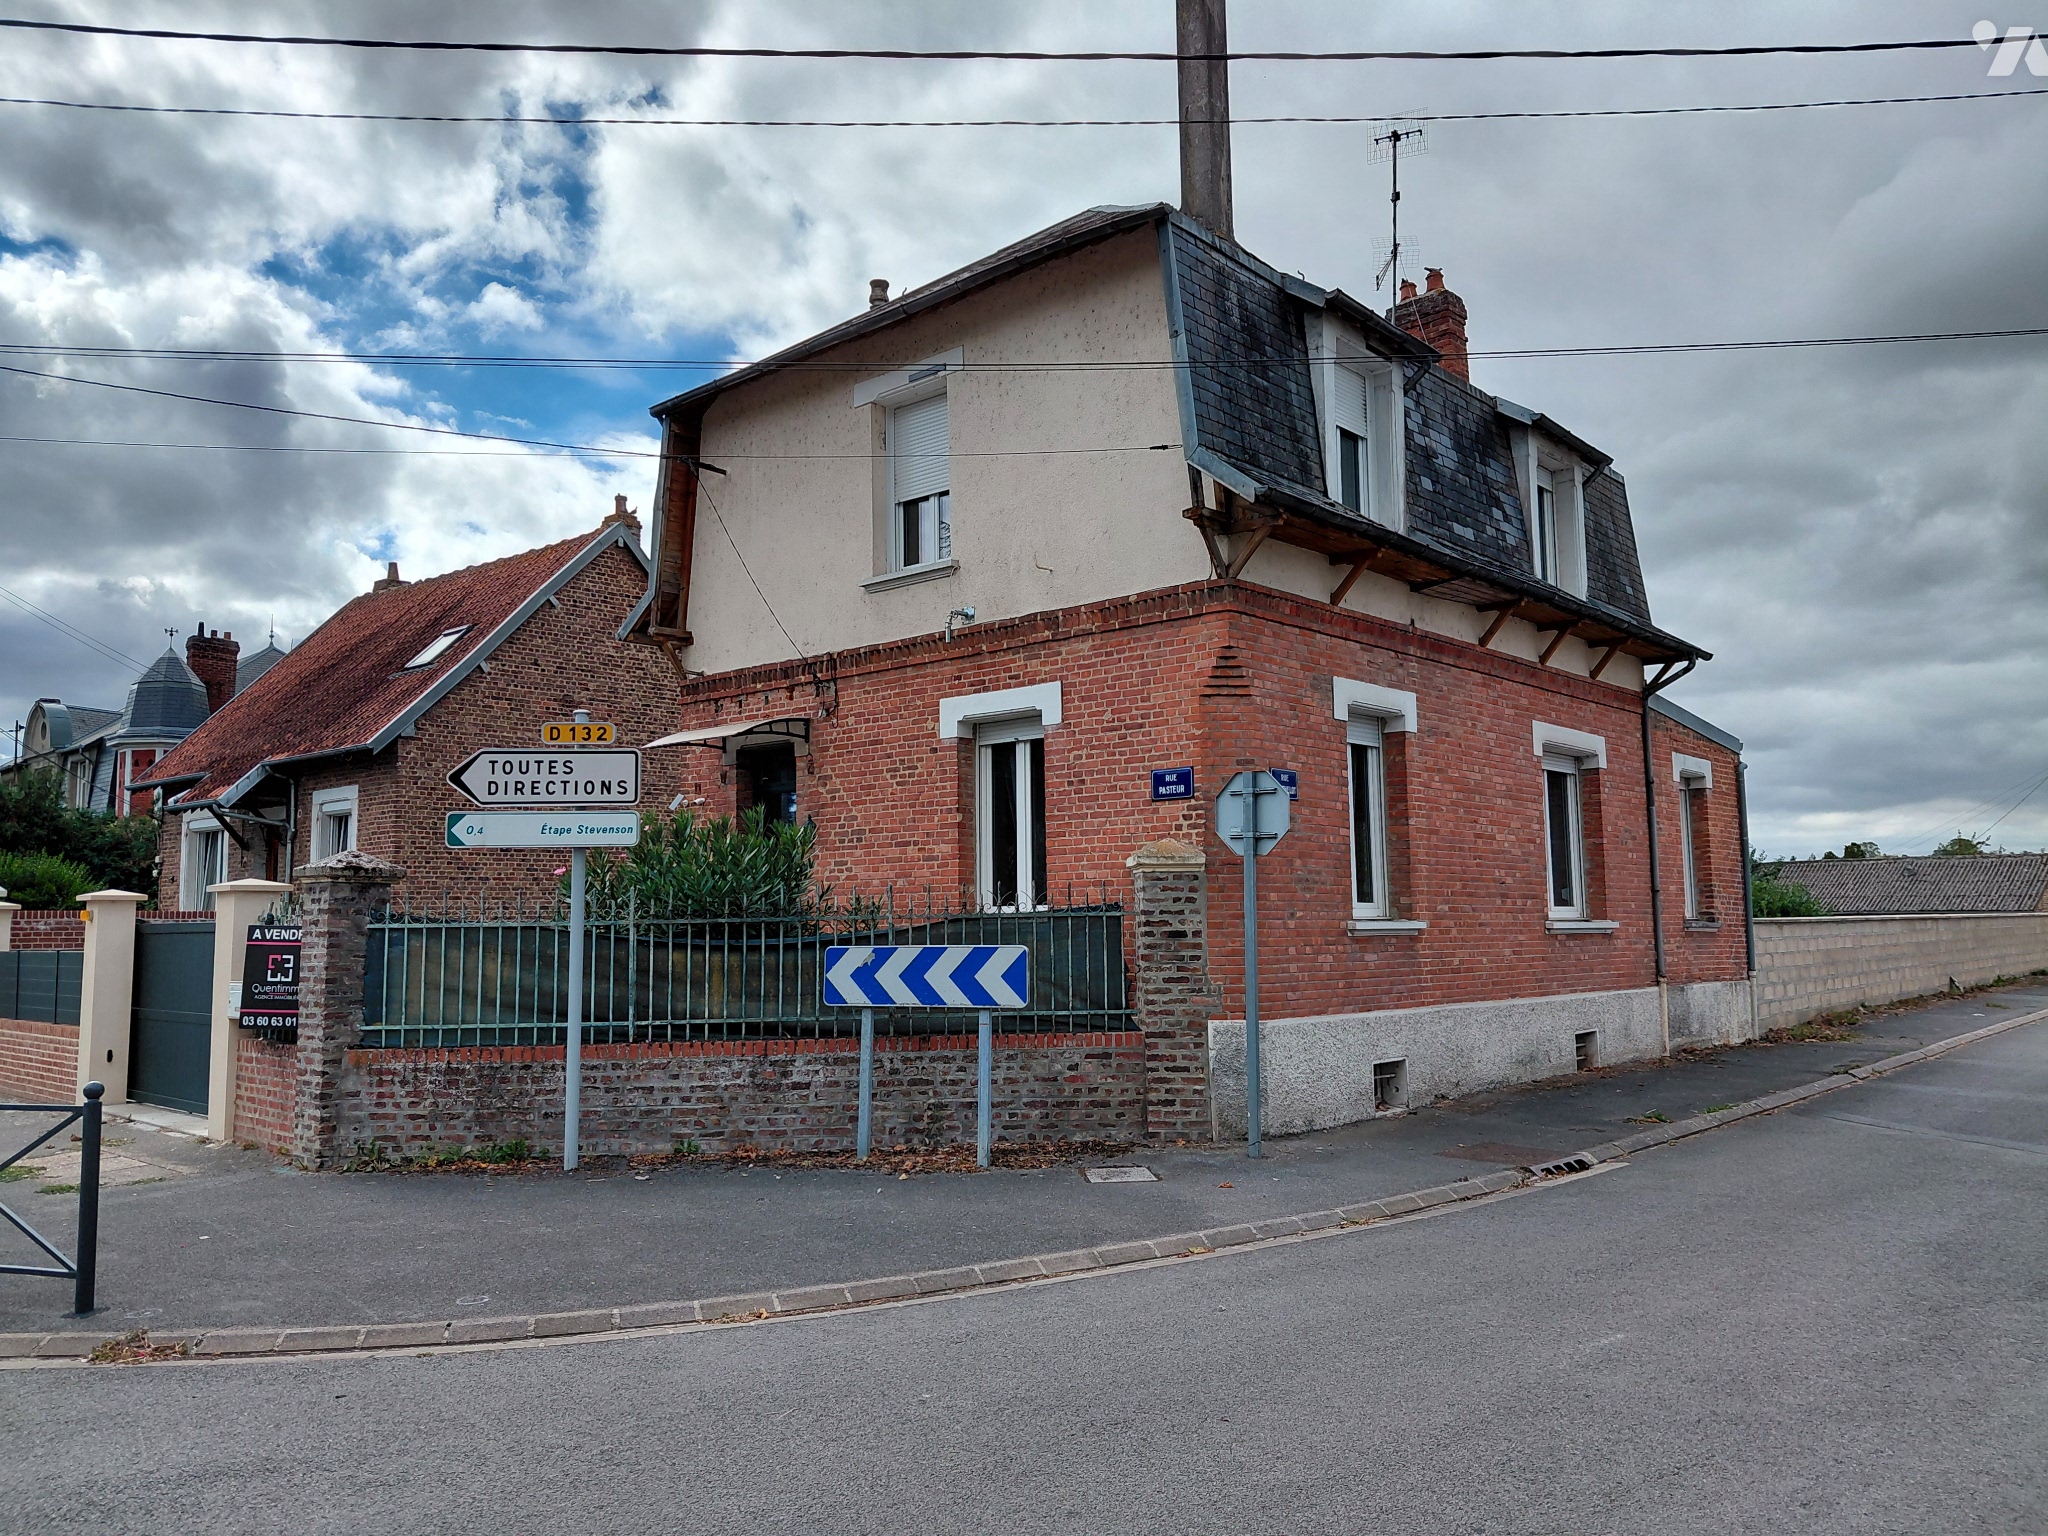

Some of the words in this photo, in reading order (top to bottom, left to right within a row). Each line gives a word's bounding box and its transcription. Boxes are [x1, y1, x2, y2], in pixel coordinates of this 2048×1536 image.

[549, 726, 561, 741] D
[569, 726, 608, 741] 132
[488, 760, 574, 775] TOUTES
[1165, 773, 1178, 782] RUE
[1280, 773, 1290, 782] RUE
[487, 780, 629, 796] DIRECTIONS
[1158, 784, 1185, 795] PASTEUR
[466, 825, 484, 837] 0,4
[540, 823, 572, 836] Étape
[576, 824, 634, 835] Stevenson
[252, 928, 262, 940] A
[242, 1015, 255, 1026] 03
[256, 1016, 269, 1026] 60
[270, 1016, 283, 1027] 63
[285, 1016, 297, 1027] 01
